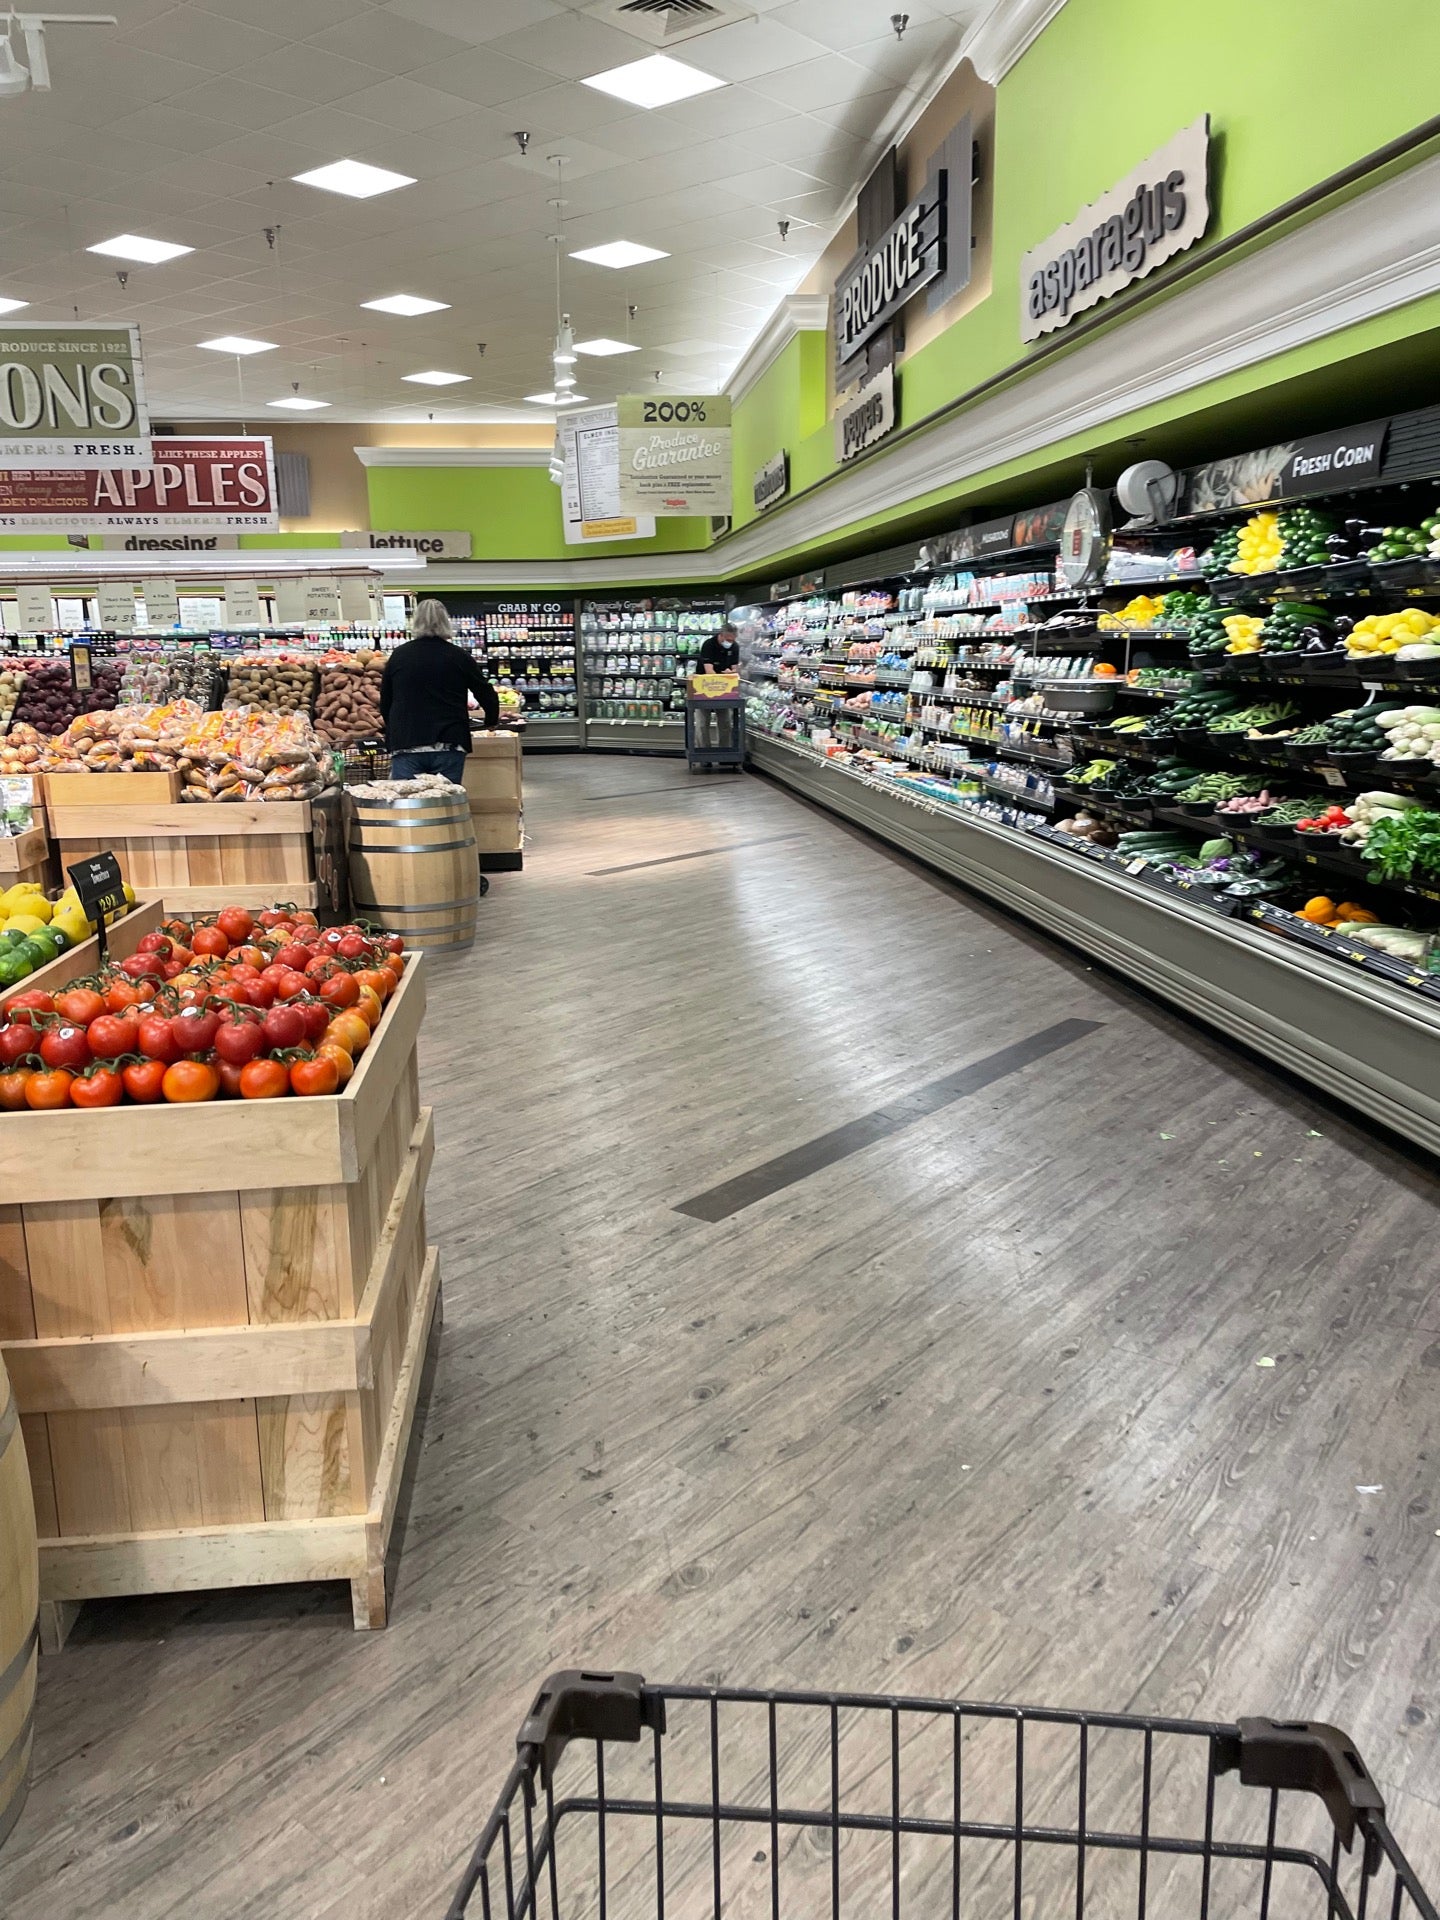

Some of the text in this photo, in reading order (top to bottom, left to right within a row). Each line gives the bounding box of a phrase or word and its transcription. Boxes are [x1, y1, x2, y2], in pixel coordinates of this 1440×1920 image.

[1028, 170, 1186, 319] asparagus
[839, 207, 924, 344] PRODUCE
[0, 342, 128, 353] RODUCE SINCE 1922
[643, 401, 706, 422] 200%
[843, 392, 883, 455] peppers
[0, 445, 143, 455] MER'S FRESH.
[649, 431, 698, 452] Produce
[159, 450, 263, 458] LIKE THESE APPLES?
[632, 439, 721, 471] Guarantee
[1291, 443, 1374, 478] FRESH CORN
[94, 463, 267, 507] APPLES
[29, 498, 88, 506] DELICIOUS
[227, 517, 273, 525] FRESH.
[125, 535, 217, 550] dressing
[369, 534, 444, 553] lettuce
[498, 603, 528, 612] GRAB
[543, 603, 561, 612] GO
